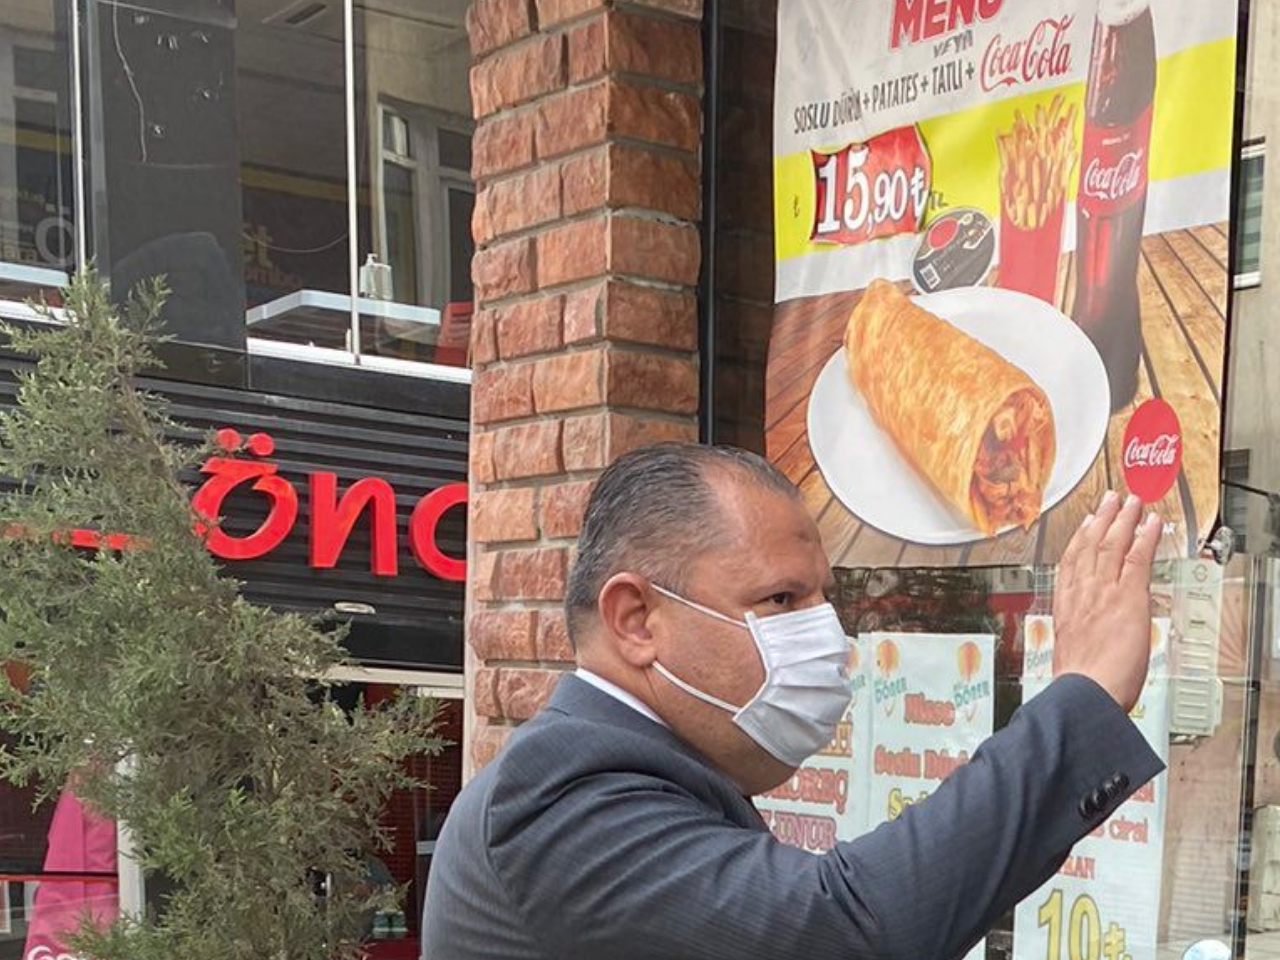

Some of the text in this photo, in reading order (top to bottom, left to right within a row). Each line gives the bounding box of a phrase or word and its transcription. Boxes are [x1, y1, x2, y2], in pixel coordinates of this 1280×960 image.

[794, 101, 831, 134] SOSLU
[872, 73, 918, 113] PATATES
[933, 58, 963, 95] TATLI
